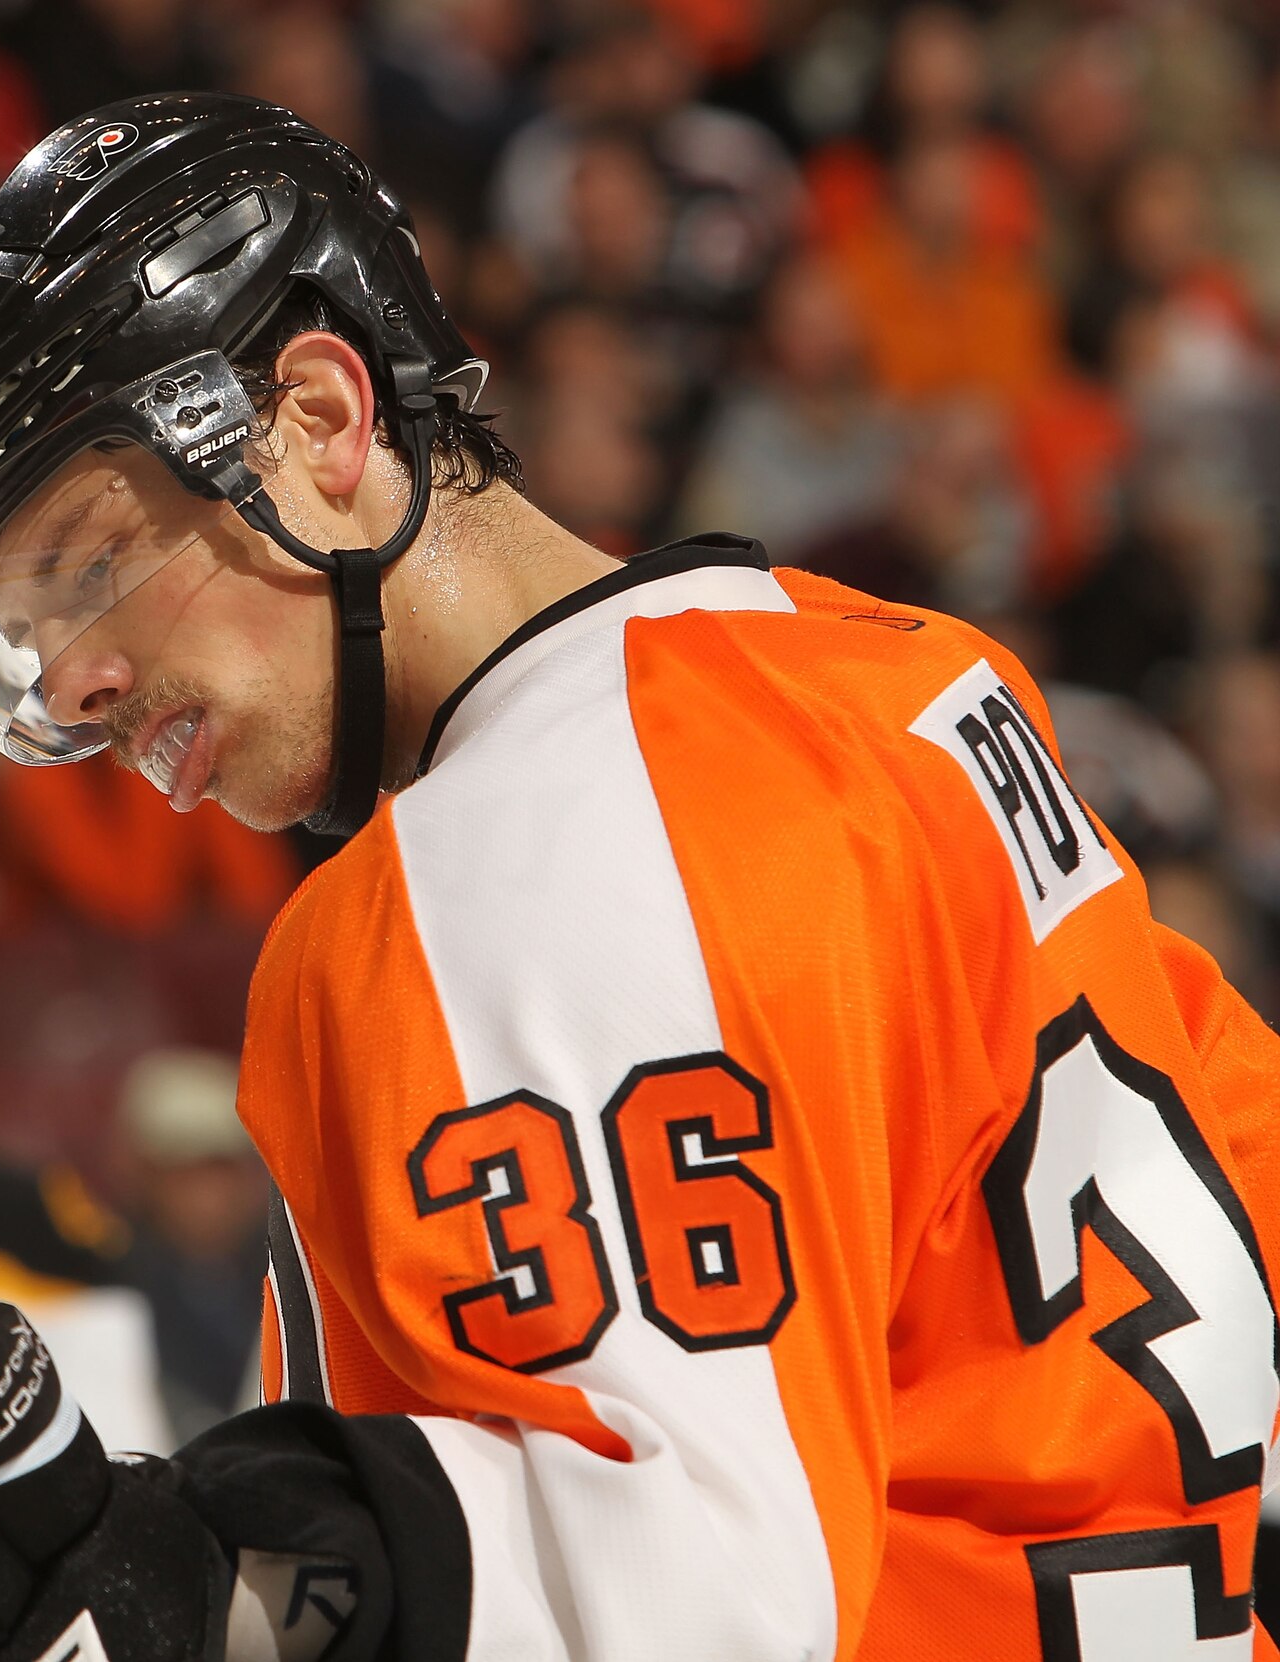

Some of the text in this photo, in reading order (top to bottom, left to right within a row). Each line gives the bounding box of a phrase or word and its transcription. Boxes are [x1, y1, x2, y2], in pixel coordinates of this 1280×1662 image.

[186, 425, 249, 464] BAUER
[956, 685, 1108, 902] PO
[406, 1050, 798, 1373] 36
